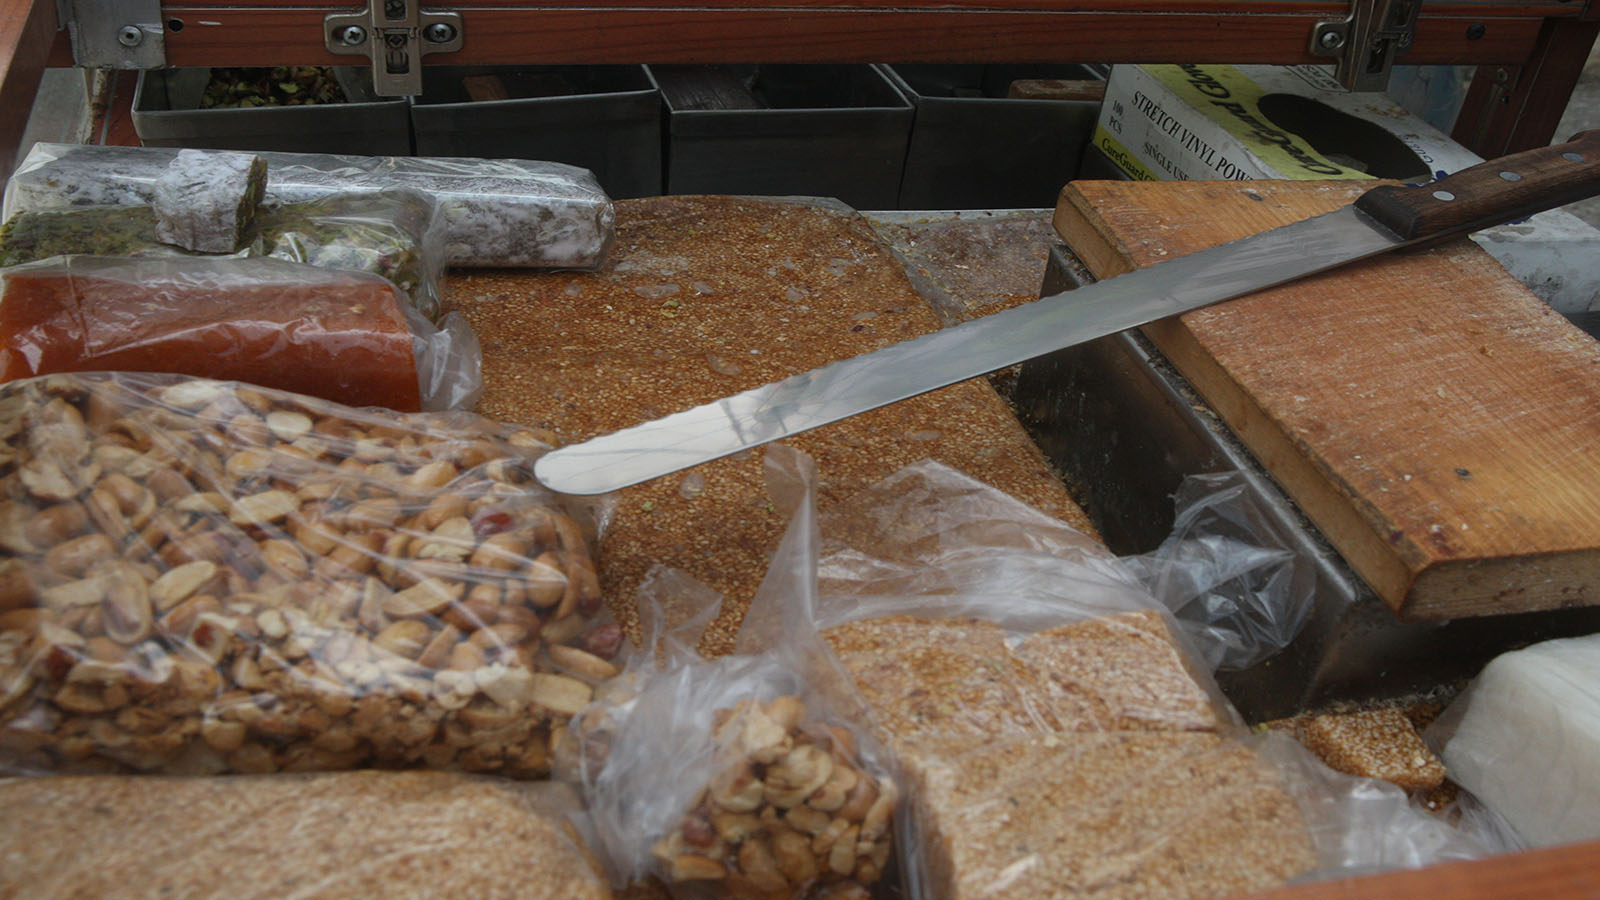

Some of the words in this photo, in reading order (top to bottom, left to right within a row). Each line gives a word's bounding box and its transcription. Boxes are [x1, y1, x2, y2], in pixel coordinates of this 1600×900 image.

[1108, 115, 1121, 135] PCS
[1131, 90, 1182, 138] STRETCH
[1180, 128, 1216, 167] VINYL
[1215, 156, 1254, 181] POW
[1144, 142, 1173, 174] SINGLE
[1173, 166, 1190, 181] USE
